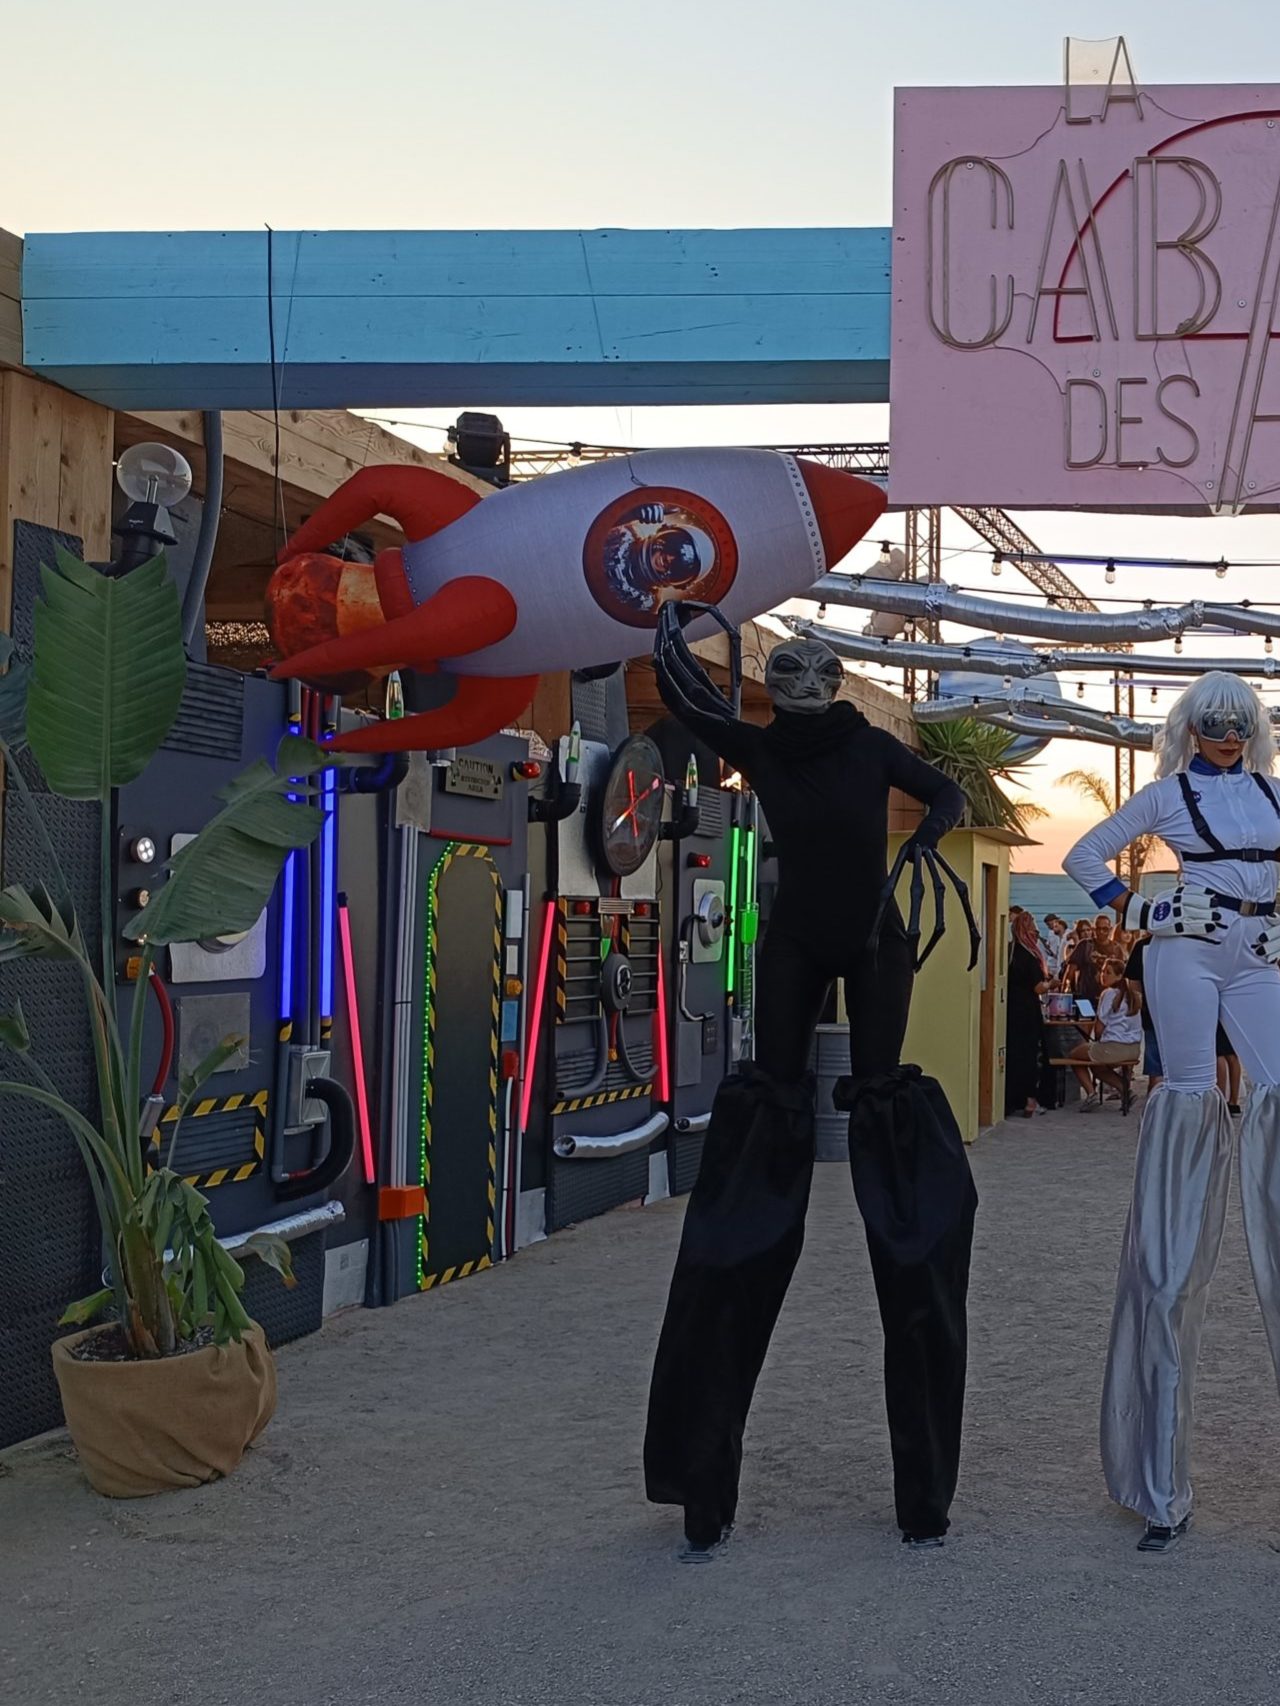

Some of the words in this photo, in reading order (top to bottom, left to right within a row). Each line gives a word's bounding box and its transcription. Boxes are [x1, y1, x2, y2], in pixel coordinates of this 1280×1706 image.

[1064, 35, 1144, 124] LA
[1064, 374, 1201, 470] DES
[459, 758, 493, 774] CAUTION
